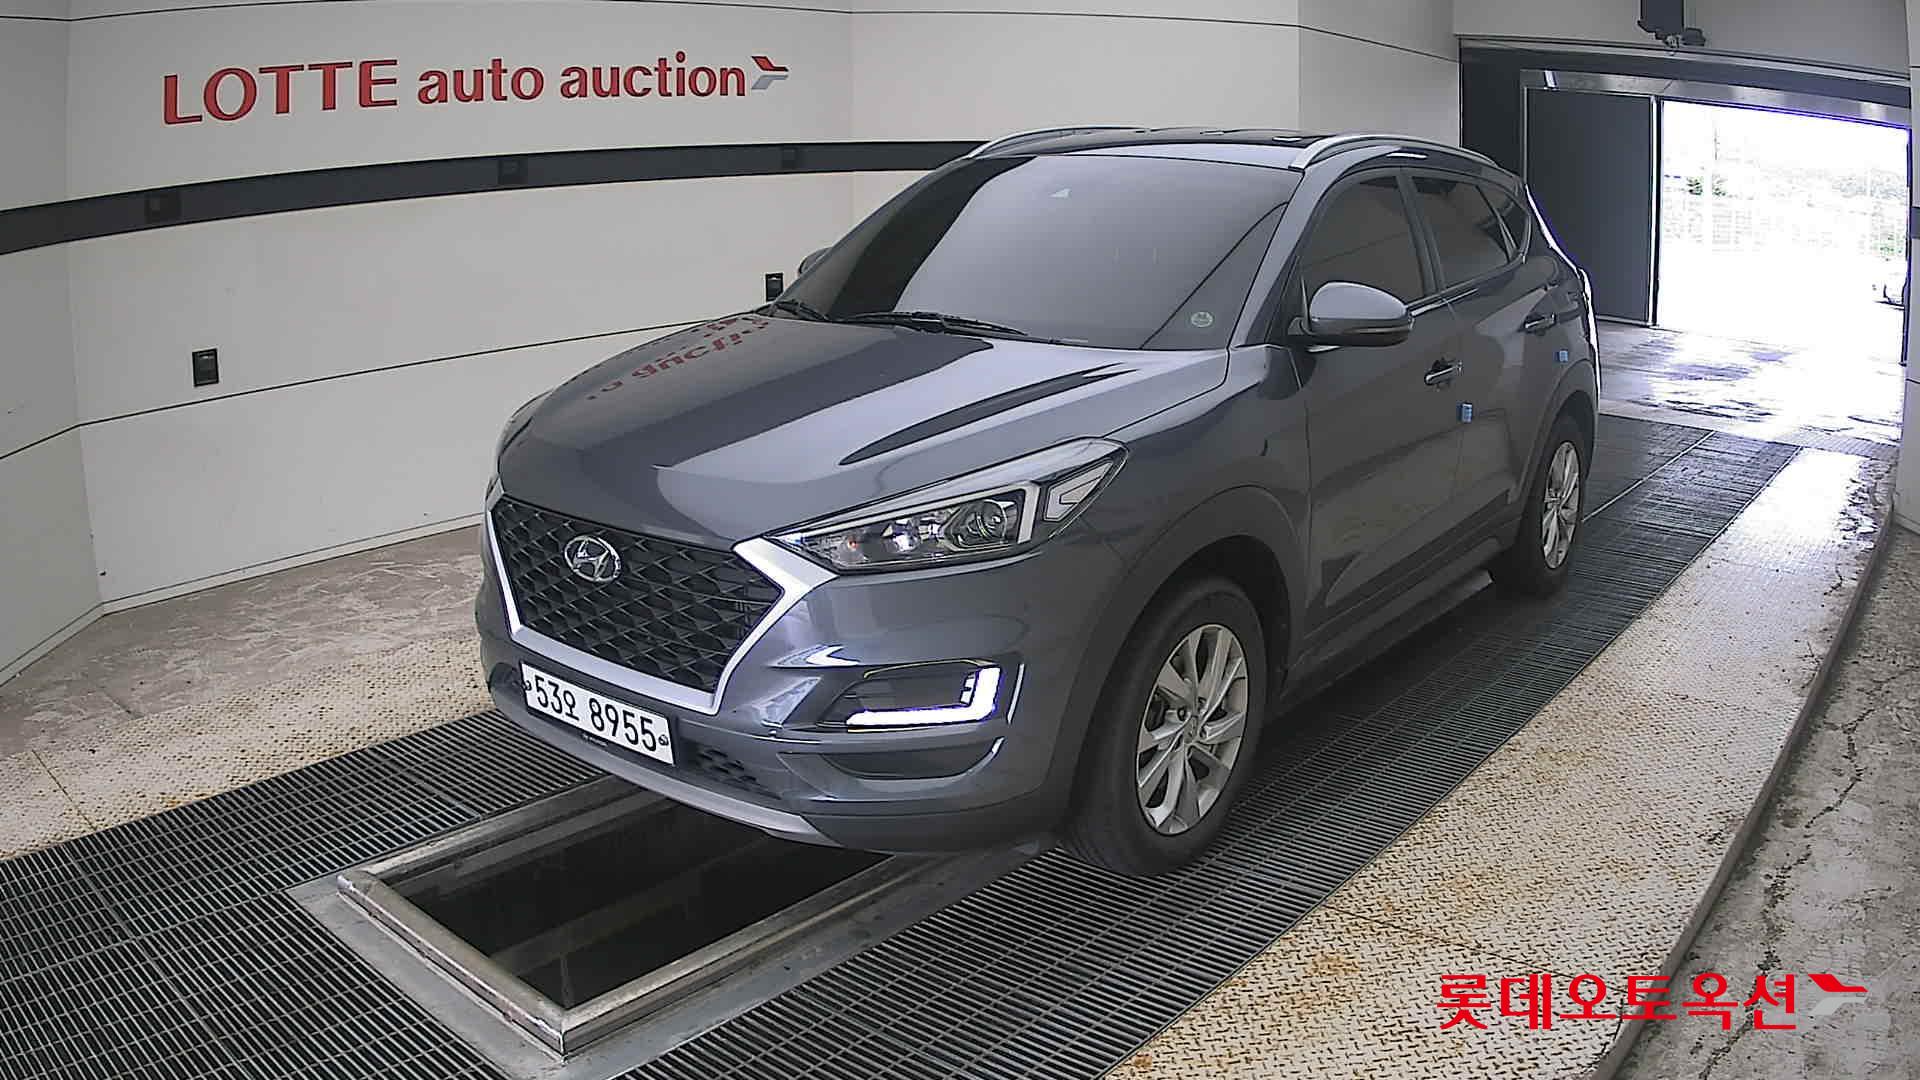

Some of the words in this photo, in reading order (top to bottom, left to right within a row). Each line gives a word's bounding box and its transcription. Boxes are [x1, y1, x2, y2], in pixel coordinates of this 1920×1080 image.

[162, 58, 398, 125] LOTTE
[416, 57, 545, 104] auto
[559, 51, 747, 98] auction
[534, 674, 580, 722] 53오
[589, 697, 657, 752] 8955
